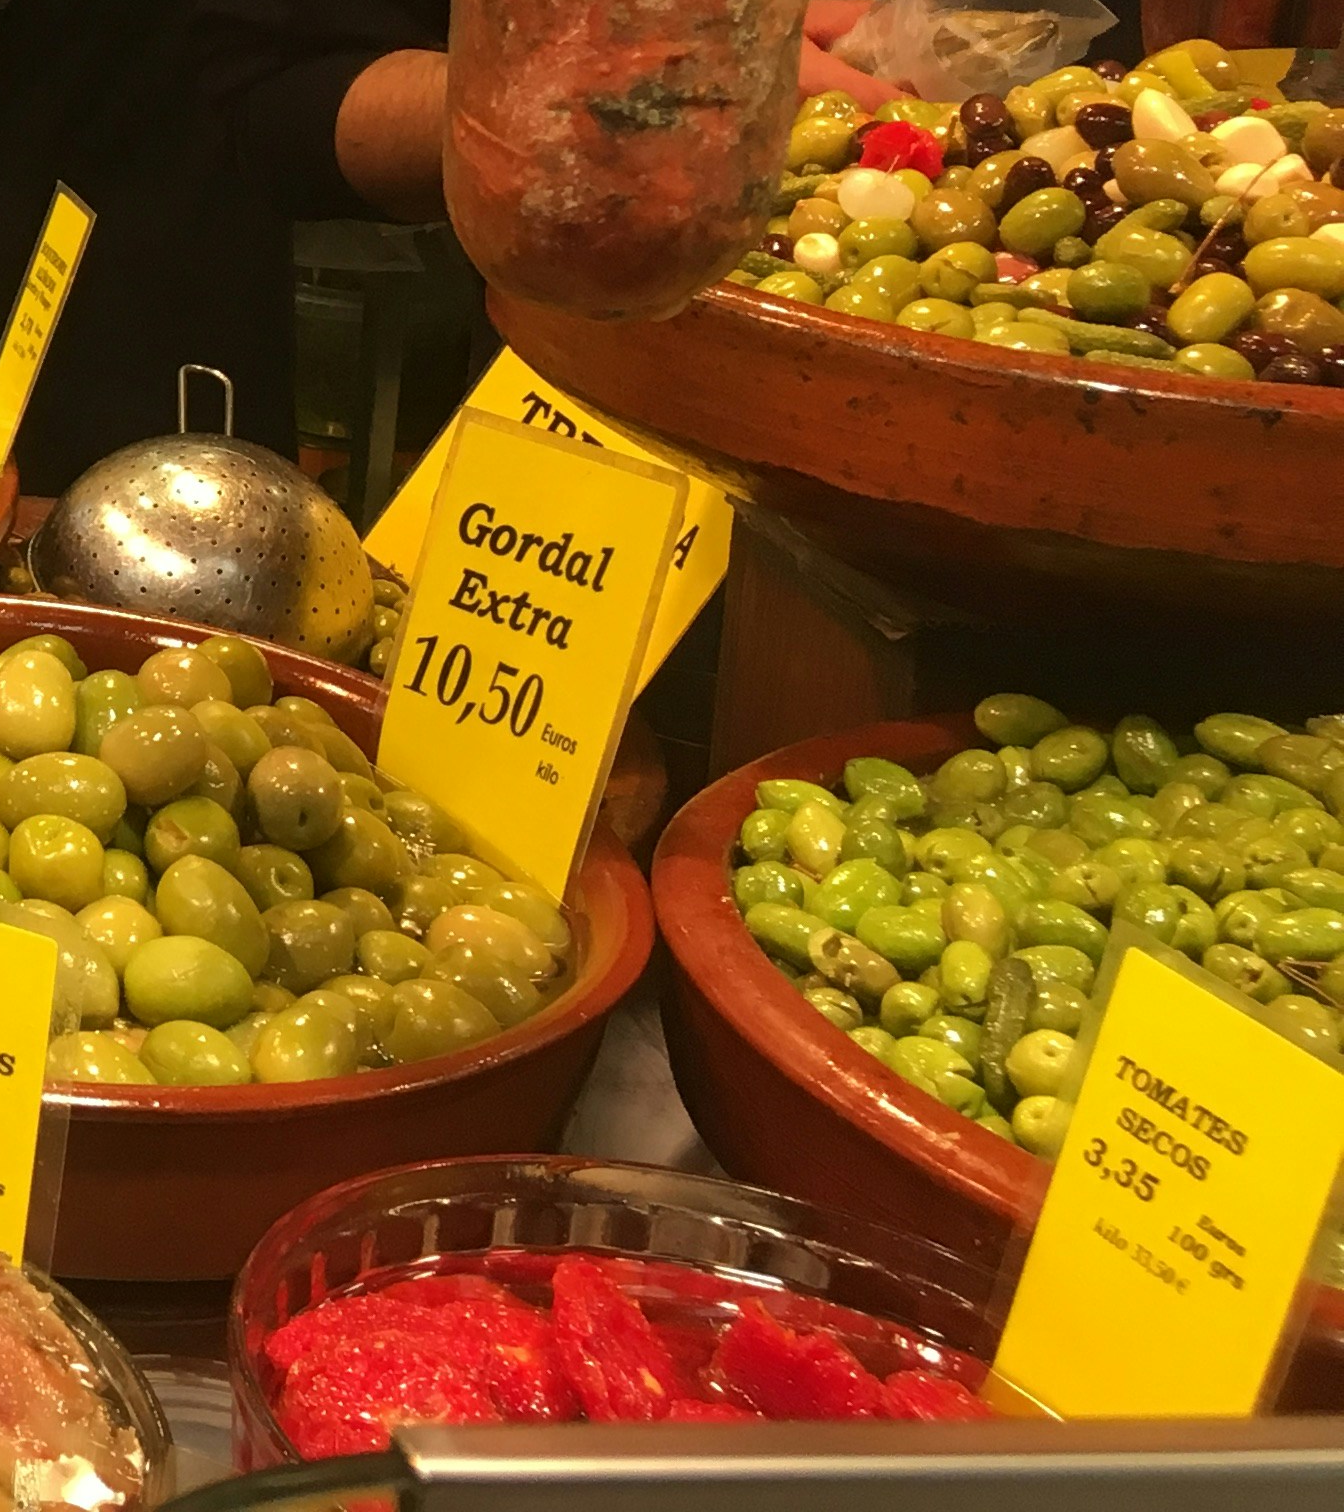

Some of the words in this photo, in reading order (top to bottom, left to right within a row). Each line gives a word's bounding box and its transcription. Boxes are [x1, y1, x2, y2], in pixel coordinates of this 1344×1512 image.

[459, 502, 615, 593] Gordal
[449, 567, 574, 650] Extra
[402, 633, 545, 738] 10,50
[540, 722, 579, 756] Euros
[535, 758, 560, 786] kilo
[1115, 1055, 1250, 1156] TOMATES
[1116, 1106, 1213, 1181] SECOS
[1082, 1137, 1162, 1203] 3,35
[1195, 1214, 1247, 1258] Euros
[1092, 1217, 1129, 1252] kilo
[1166, 1225, 1211, 1263] 100
[1207, 1259, 1246, 1291] grs
